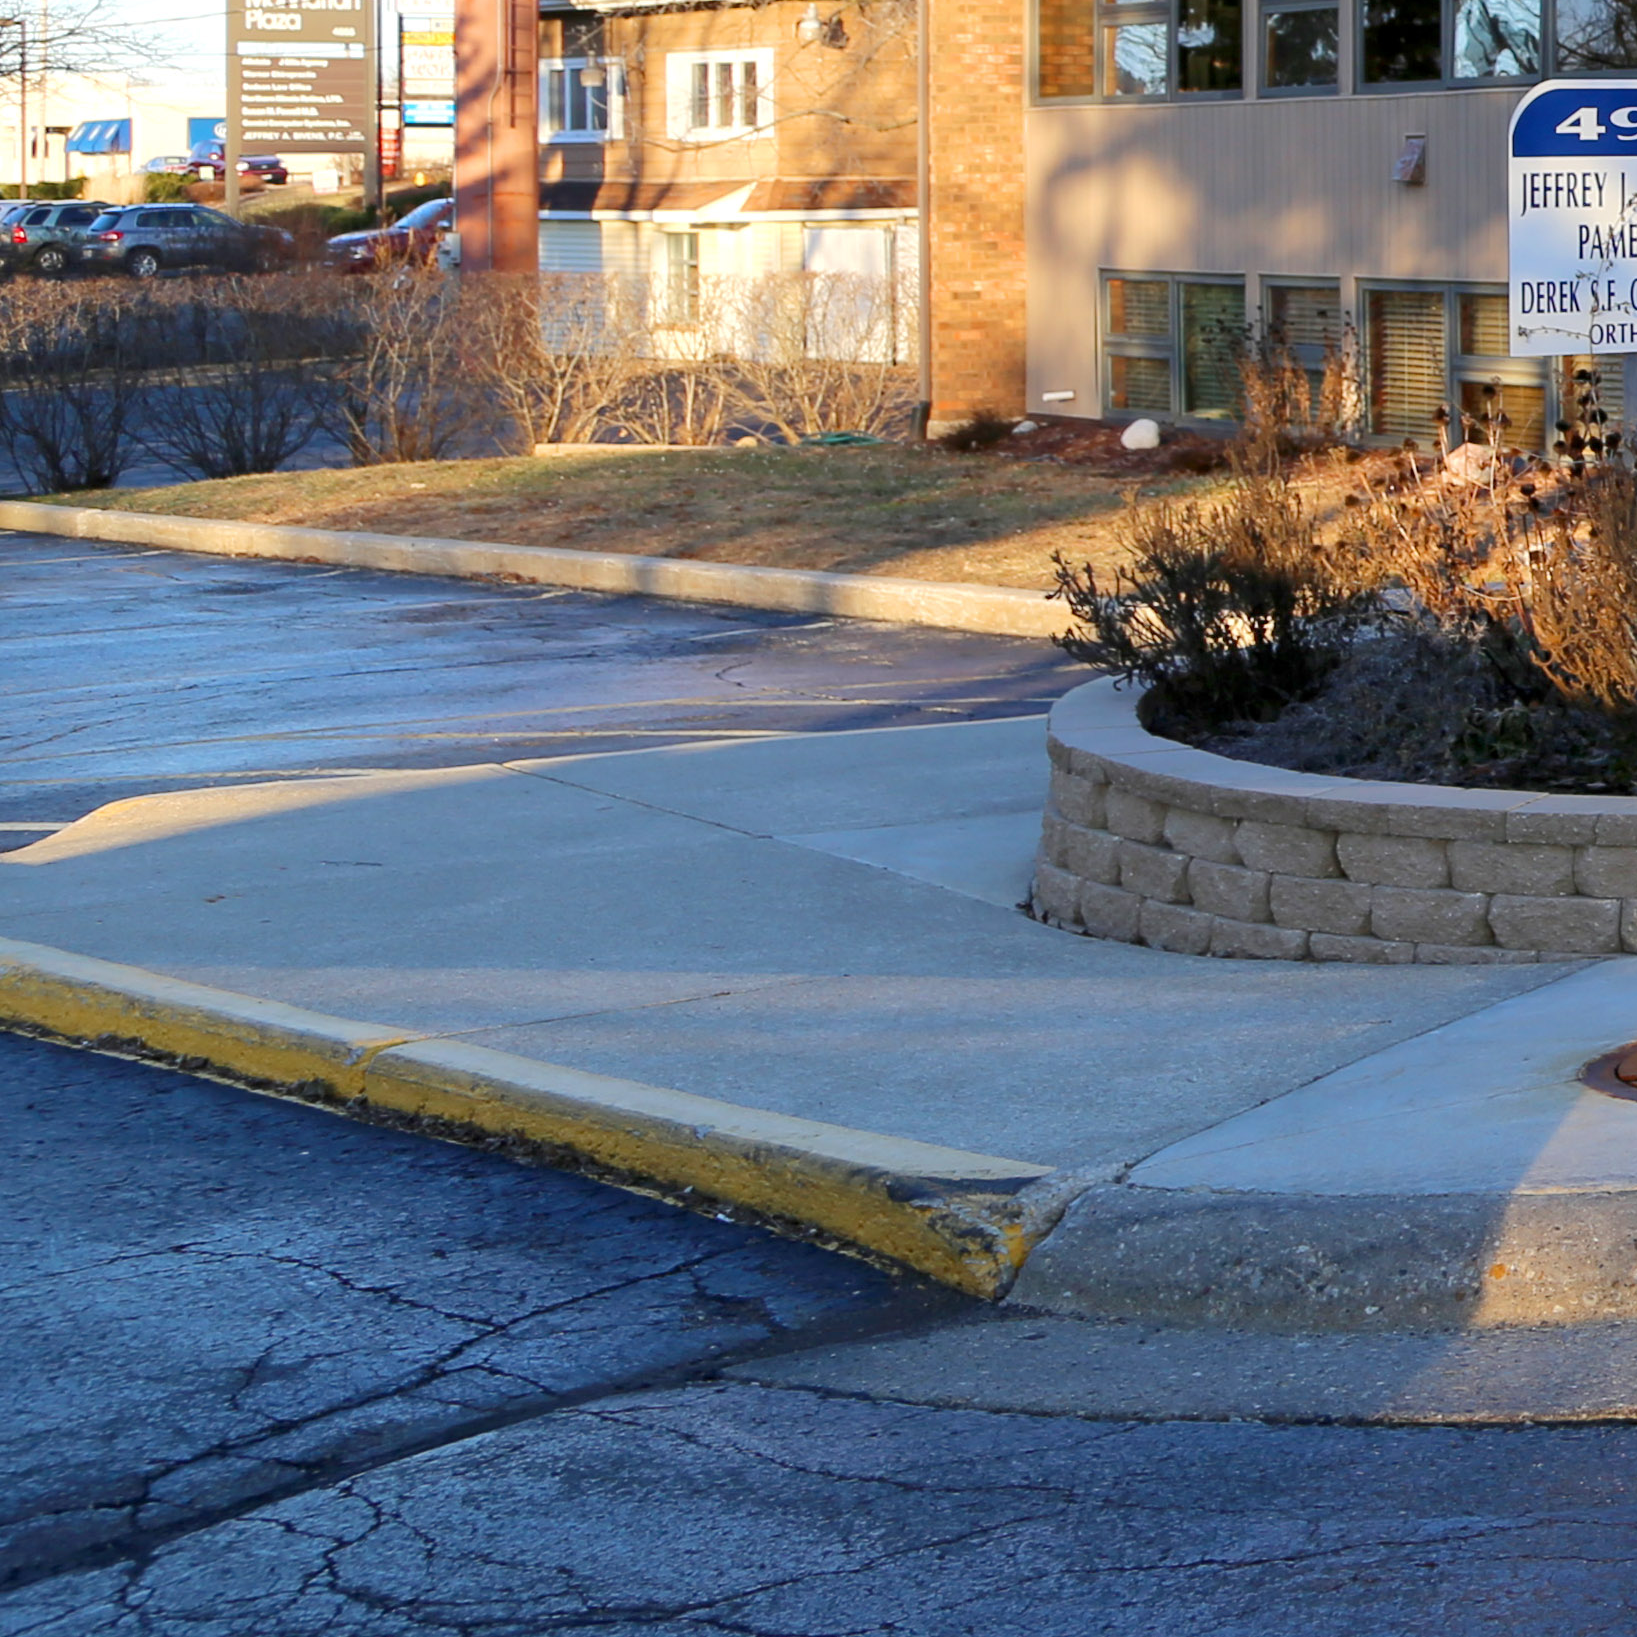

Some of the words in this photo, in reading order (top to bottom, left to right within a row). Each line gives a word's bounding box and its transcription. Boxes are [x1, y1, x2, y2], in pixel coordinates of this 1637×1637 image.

[245, 8, 302, 31] Plaza
[1520, 171, 1607, 216] JEFFREY
[1521, 280, 1580, 314] DEREK
